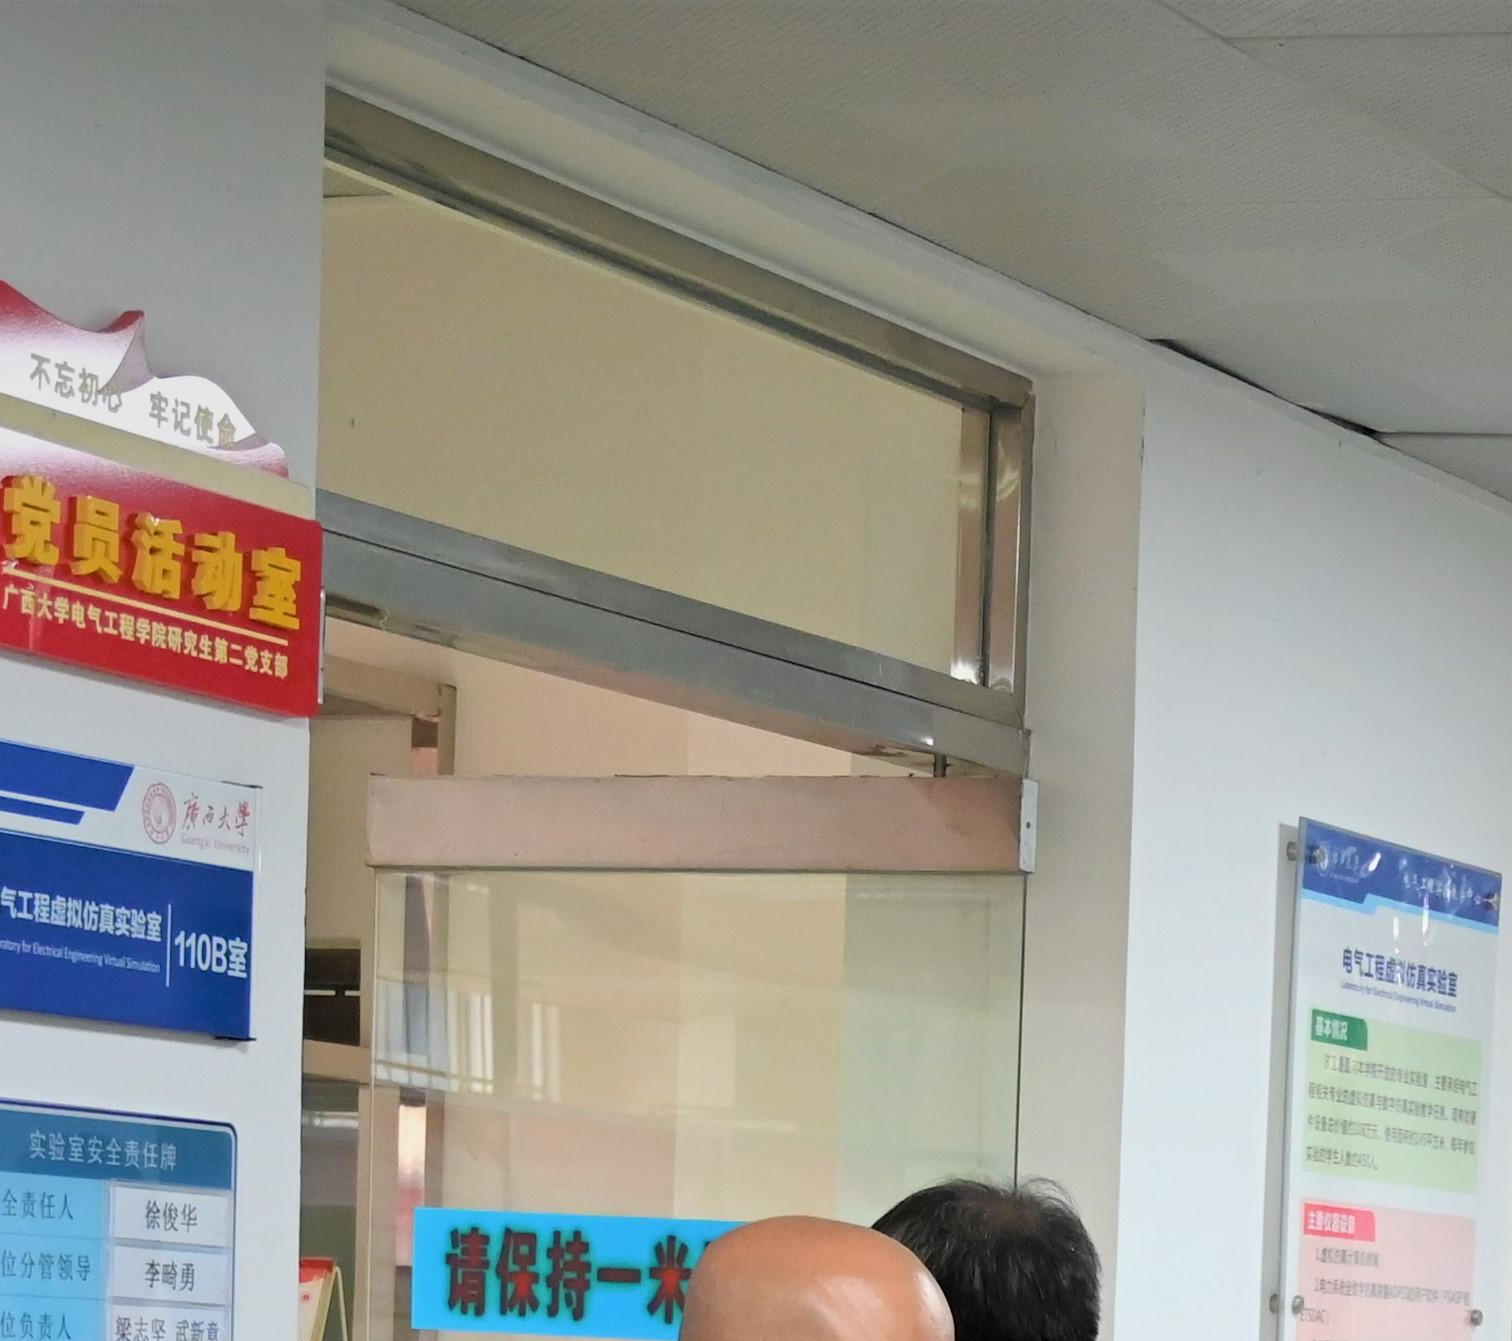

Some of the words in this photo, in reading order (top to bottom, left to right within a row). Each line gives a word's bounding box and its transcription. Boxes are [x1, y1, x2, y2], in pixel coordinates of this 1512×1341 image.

[30, 353, 122, 413] 不忘初心
[2, 474, 302, 630] 党员活动室
[3, 584, 288, 680] 广西大学电气工程学院研究生第二党支部
[22, 939, 32, 953] for
[33, 941, 64, 958] Electrical
[64, 947, 103, 968] Engineering
[174, 930, 249, 979] 110B室
[1314, 1015, 1349, 1041] 基本情况
[28, 1129, 178, 1171] 实验室安全责任牌
[145, 1199, 198, 1233] 徐俊华
[444, 1226, 709, 1324] 请保持一米
